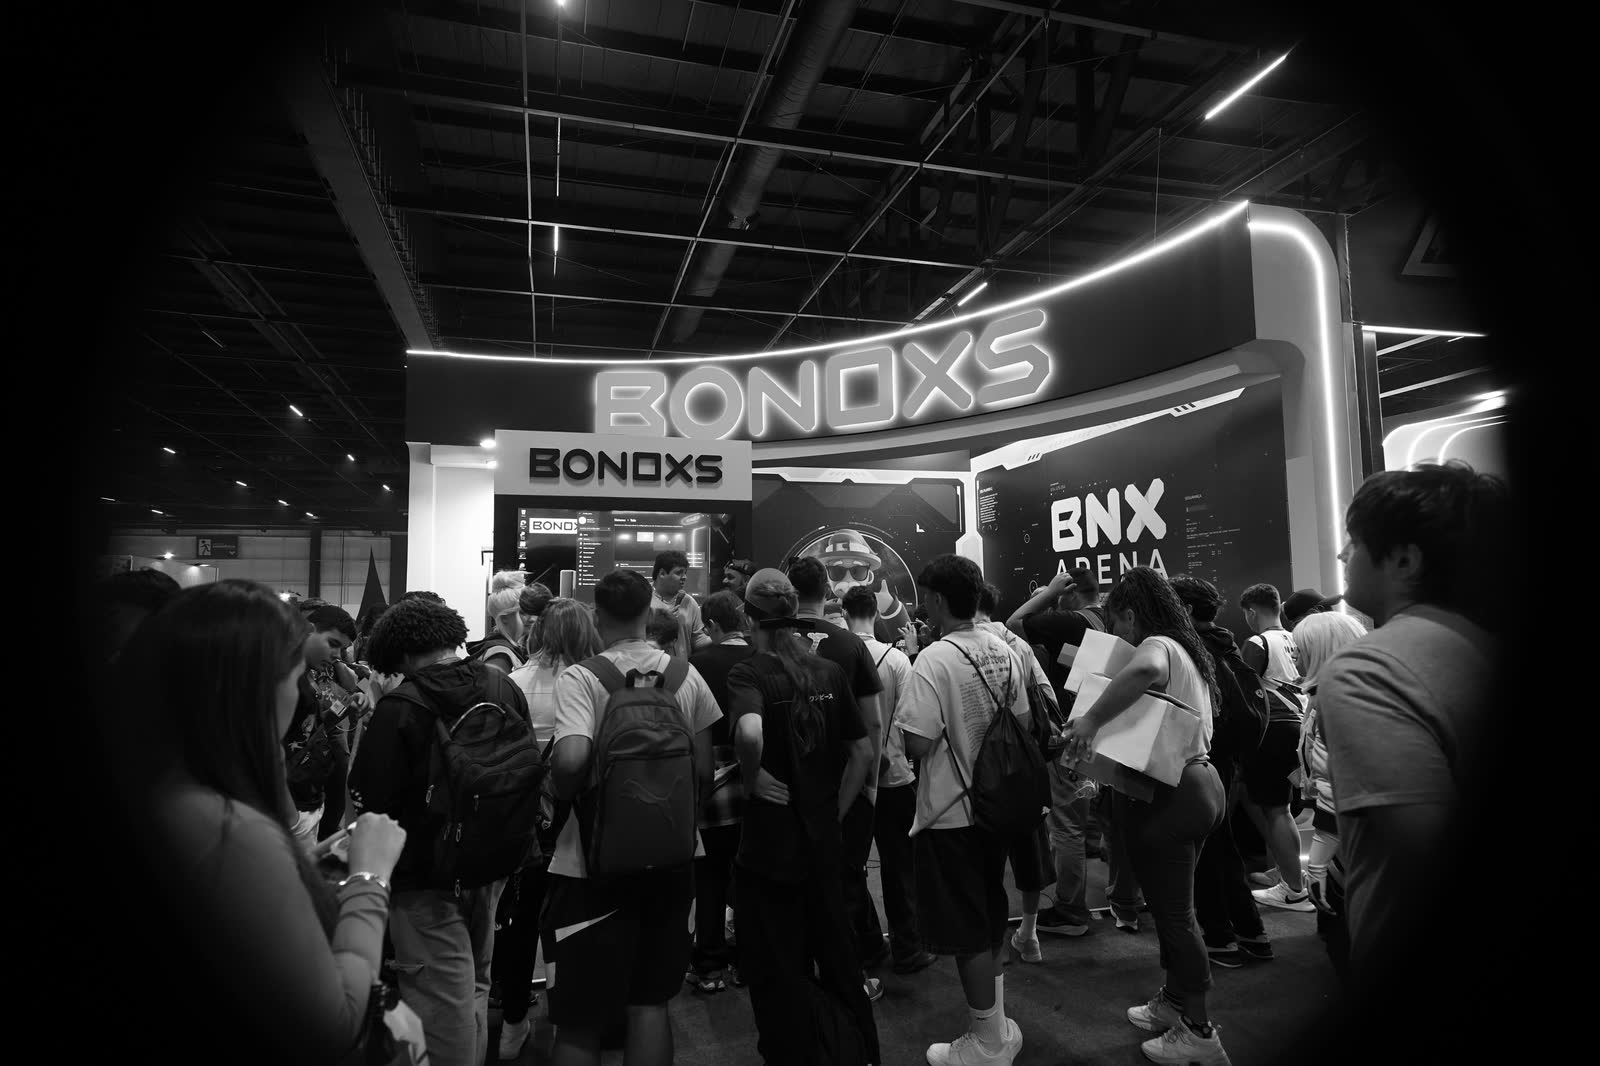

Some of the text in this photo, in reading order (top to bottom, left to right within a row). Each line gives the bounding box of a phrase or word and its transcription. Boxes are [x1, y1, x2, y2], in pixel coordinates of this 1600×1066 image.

[595, 308, 1051, 440] BONOXS
[529, 447, 723, 483] BONOXS
[1050, 477, 1167, 553] BNX
